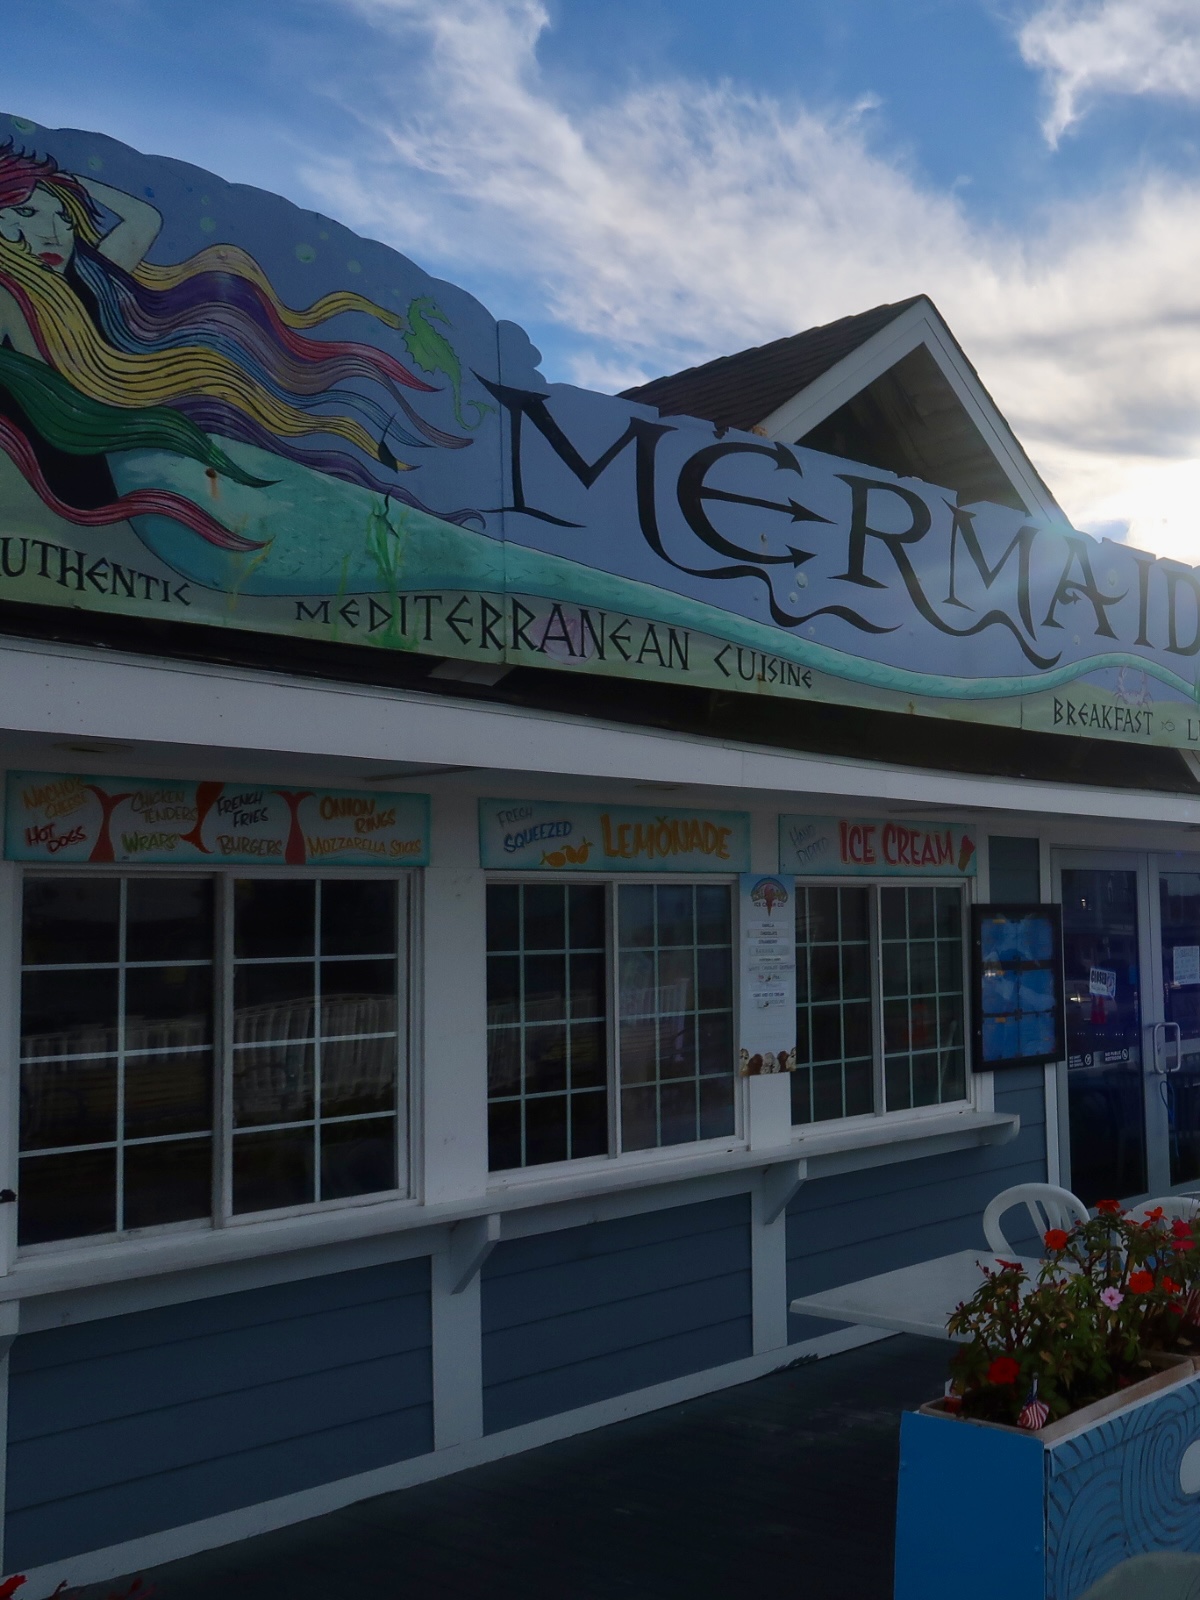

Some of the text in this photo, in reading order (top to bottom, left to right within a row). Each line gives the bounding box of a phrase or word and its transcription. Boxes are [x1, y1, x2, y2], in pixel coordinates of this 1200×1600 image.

[0, 537, 813, 689] UTHENTIC MEDITERRANEAN CUISINE
[1053, 697, 1153, 736] BREAKFAST
[140, 806, 197, 824] TENDERS
[216, 791, 263, 816] FRENCH
[319, 796, 376, 820] ONION
[232, 808, 269, 828] FRIES
[355, 808, 396, 834] RINGS
[26, 823, 55, 846] HOT
[47, 825, 86, 853] DOGS
[217, 835, 282, 856] BURGERS
[306, 836, 422, 857] MOZZARELLA STICKS
[503, 820, 573, 854] SQUEEZED
[600, 812, 733, 859] LEMONADE
[839, 820, 954, 867] ICE CREAM
